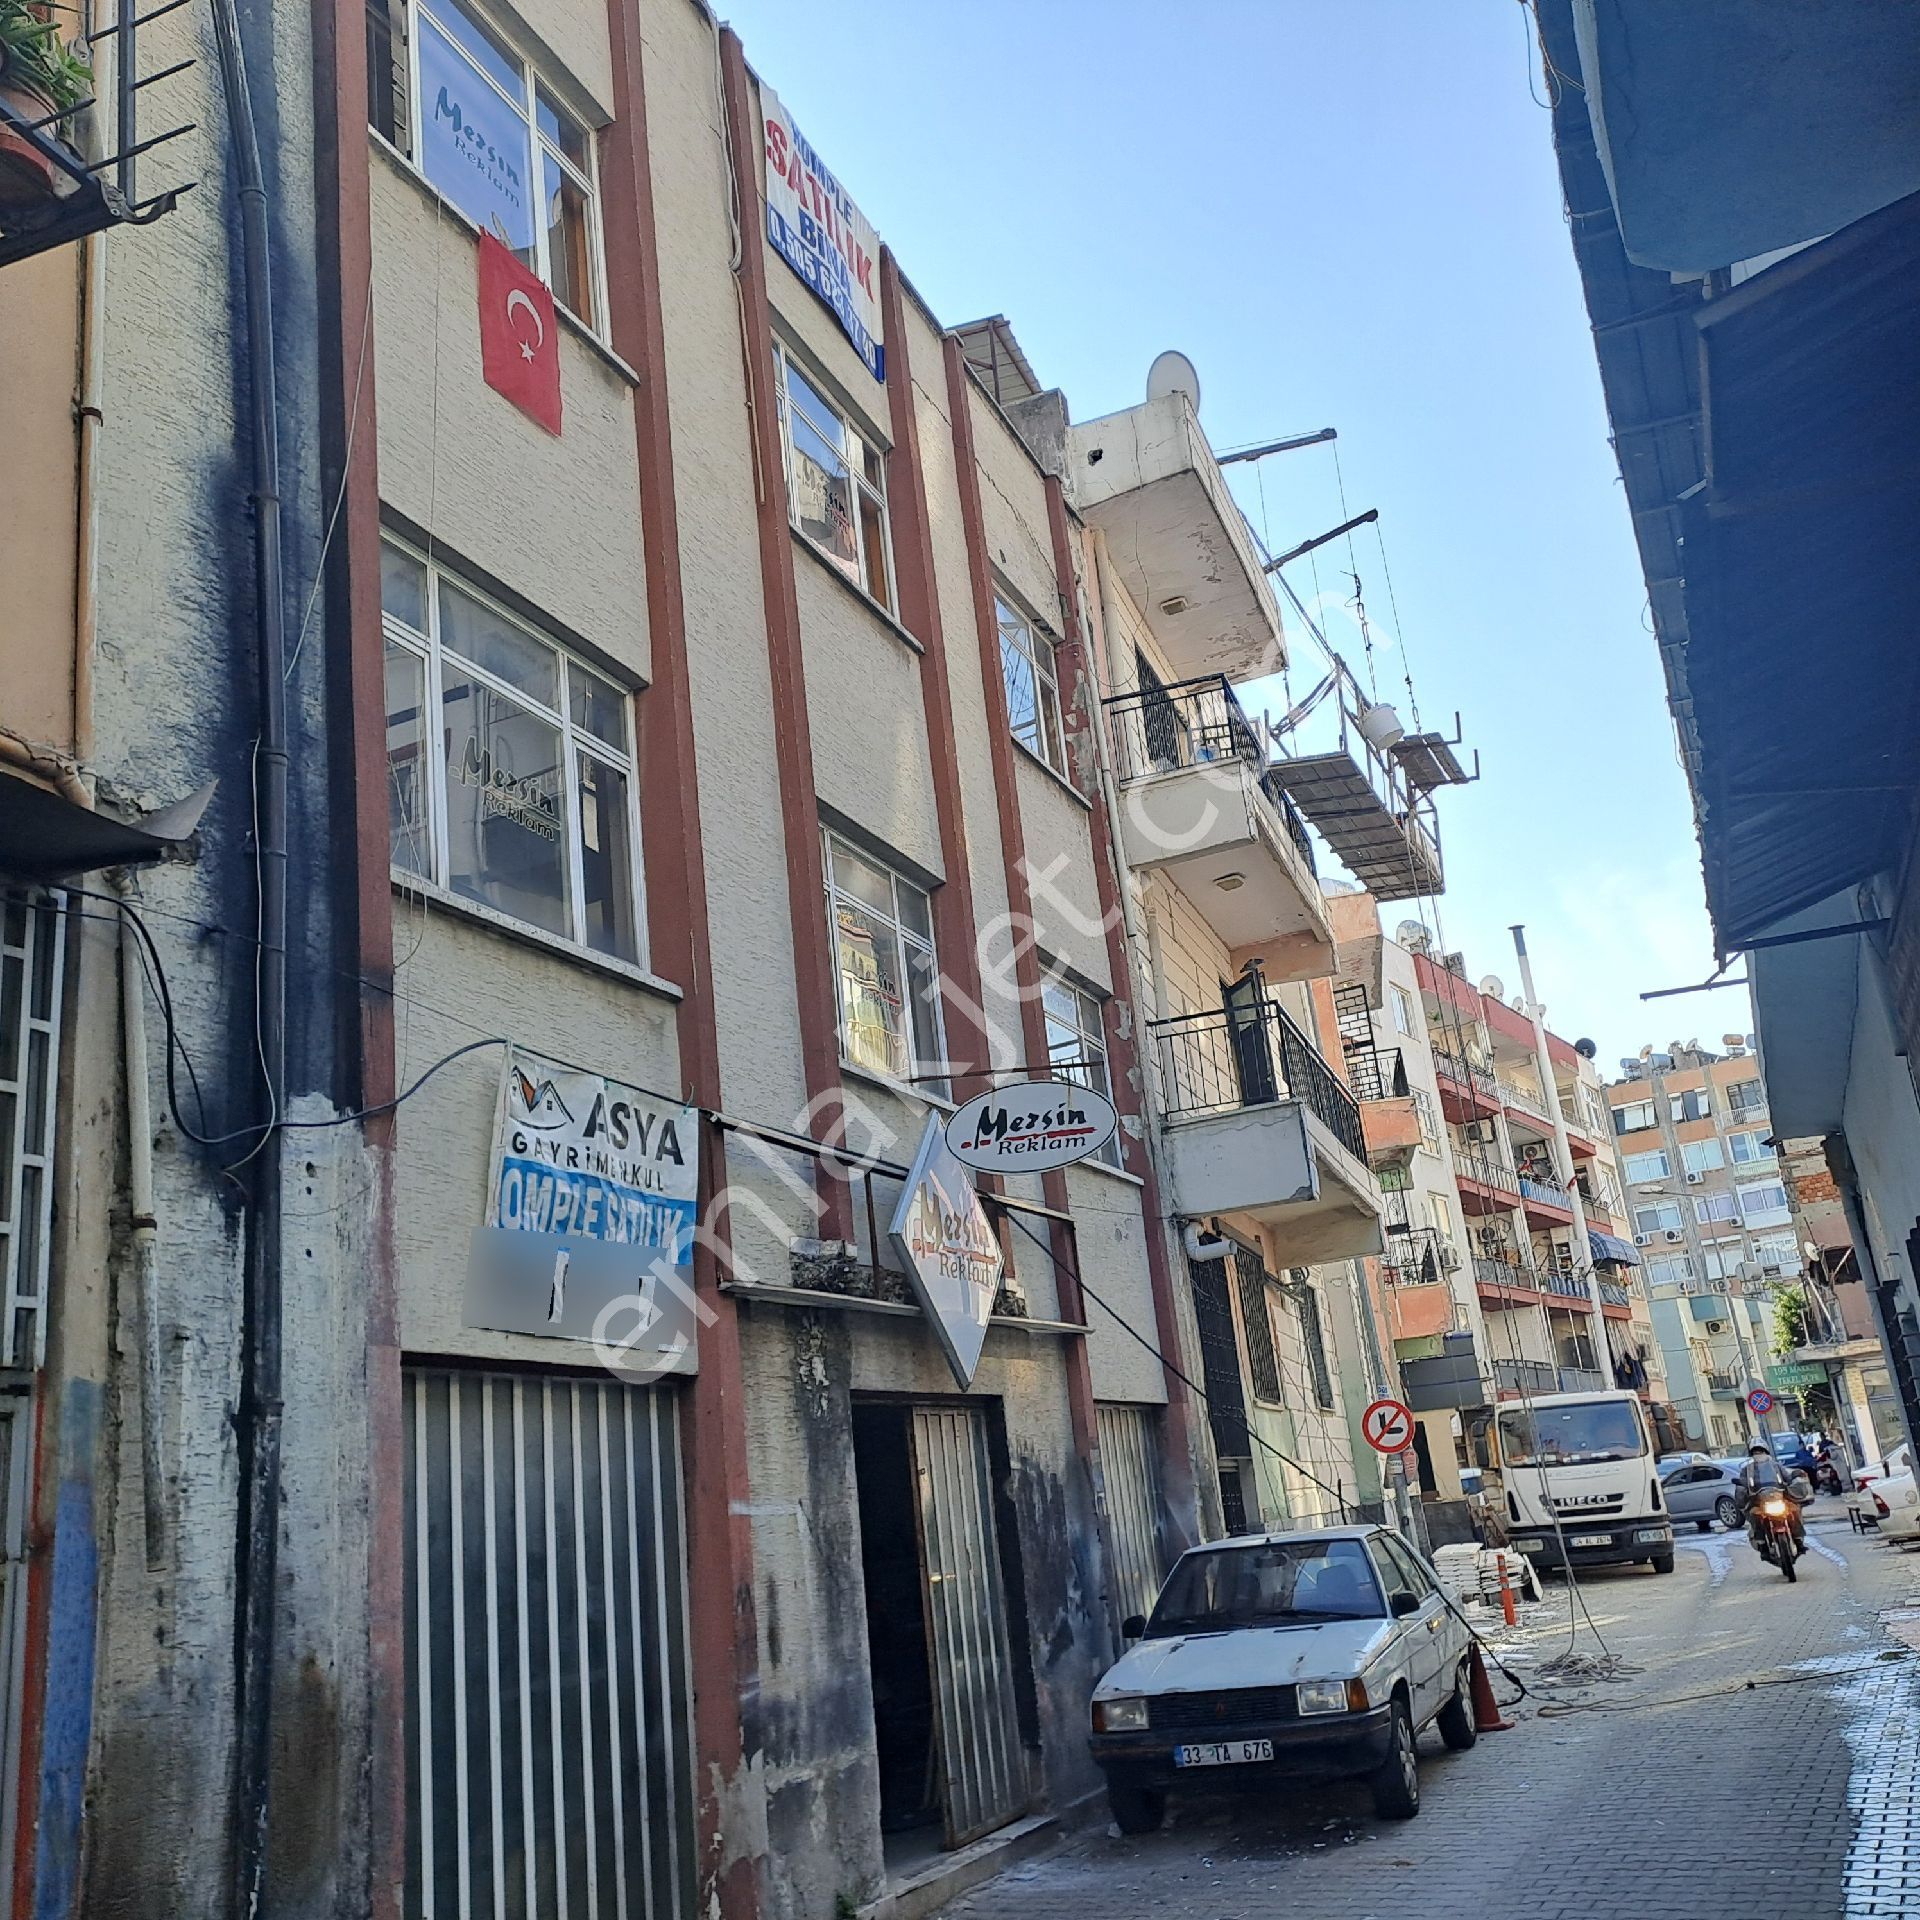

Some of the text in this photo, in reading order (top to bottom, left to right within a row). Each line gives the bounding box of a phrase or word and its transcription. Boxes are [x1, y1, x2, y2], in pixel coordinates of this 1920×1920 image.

[435, 86, 519, 187] Mersin
[456, 135, 519, 208] Reklam
[765, 119, 876, 305] SATILIK
[461, 736, 555, 817] Mersin
[482, 790, 555, 842] Reklam
[582, 1092, 685, 1166] ASYA
[973, 1102, 1087, 1150] Mersin
[998, 1136, 1086, 1155] Reklam
[511, 1131, 665, 1193] GAYRİMENKUL
[919, 1182, 991, 1259] Mersin
[939, 1252, 994, 1288] Reklam
[1559, 1495, 1608, 1508] IVECO
[1183, 1741, 1272, 1764] 33 TA 676
